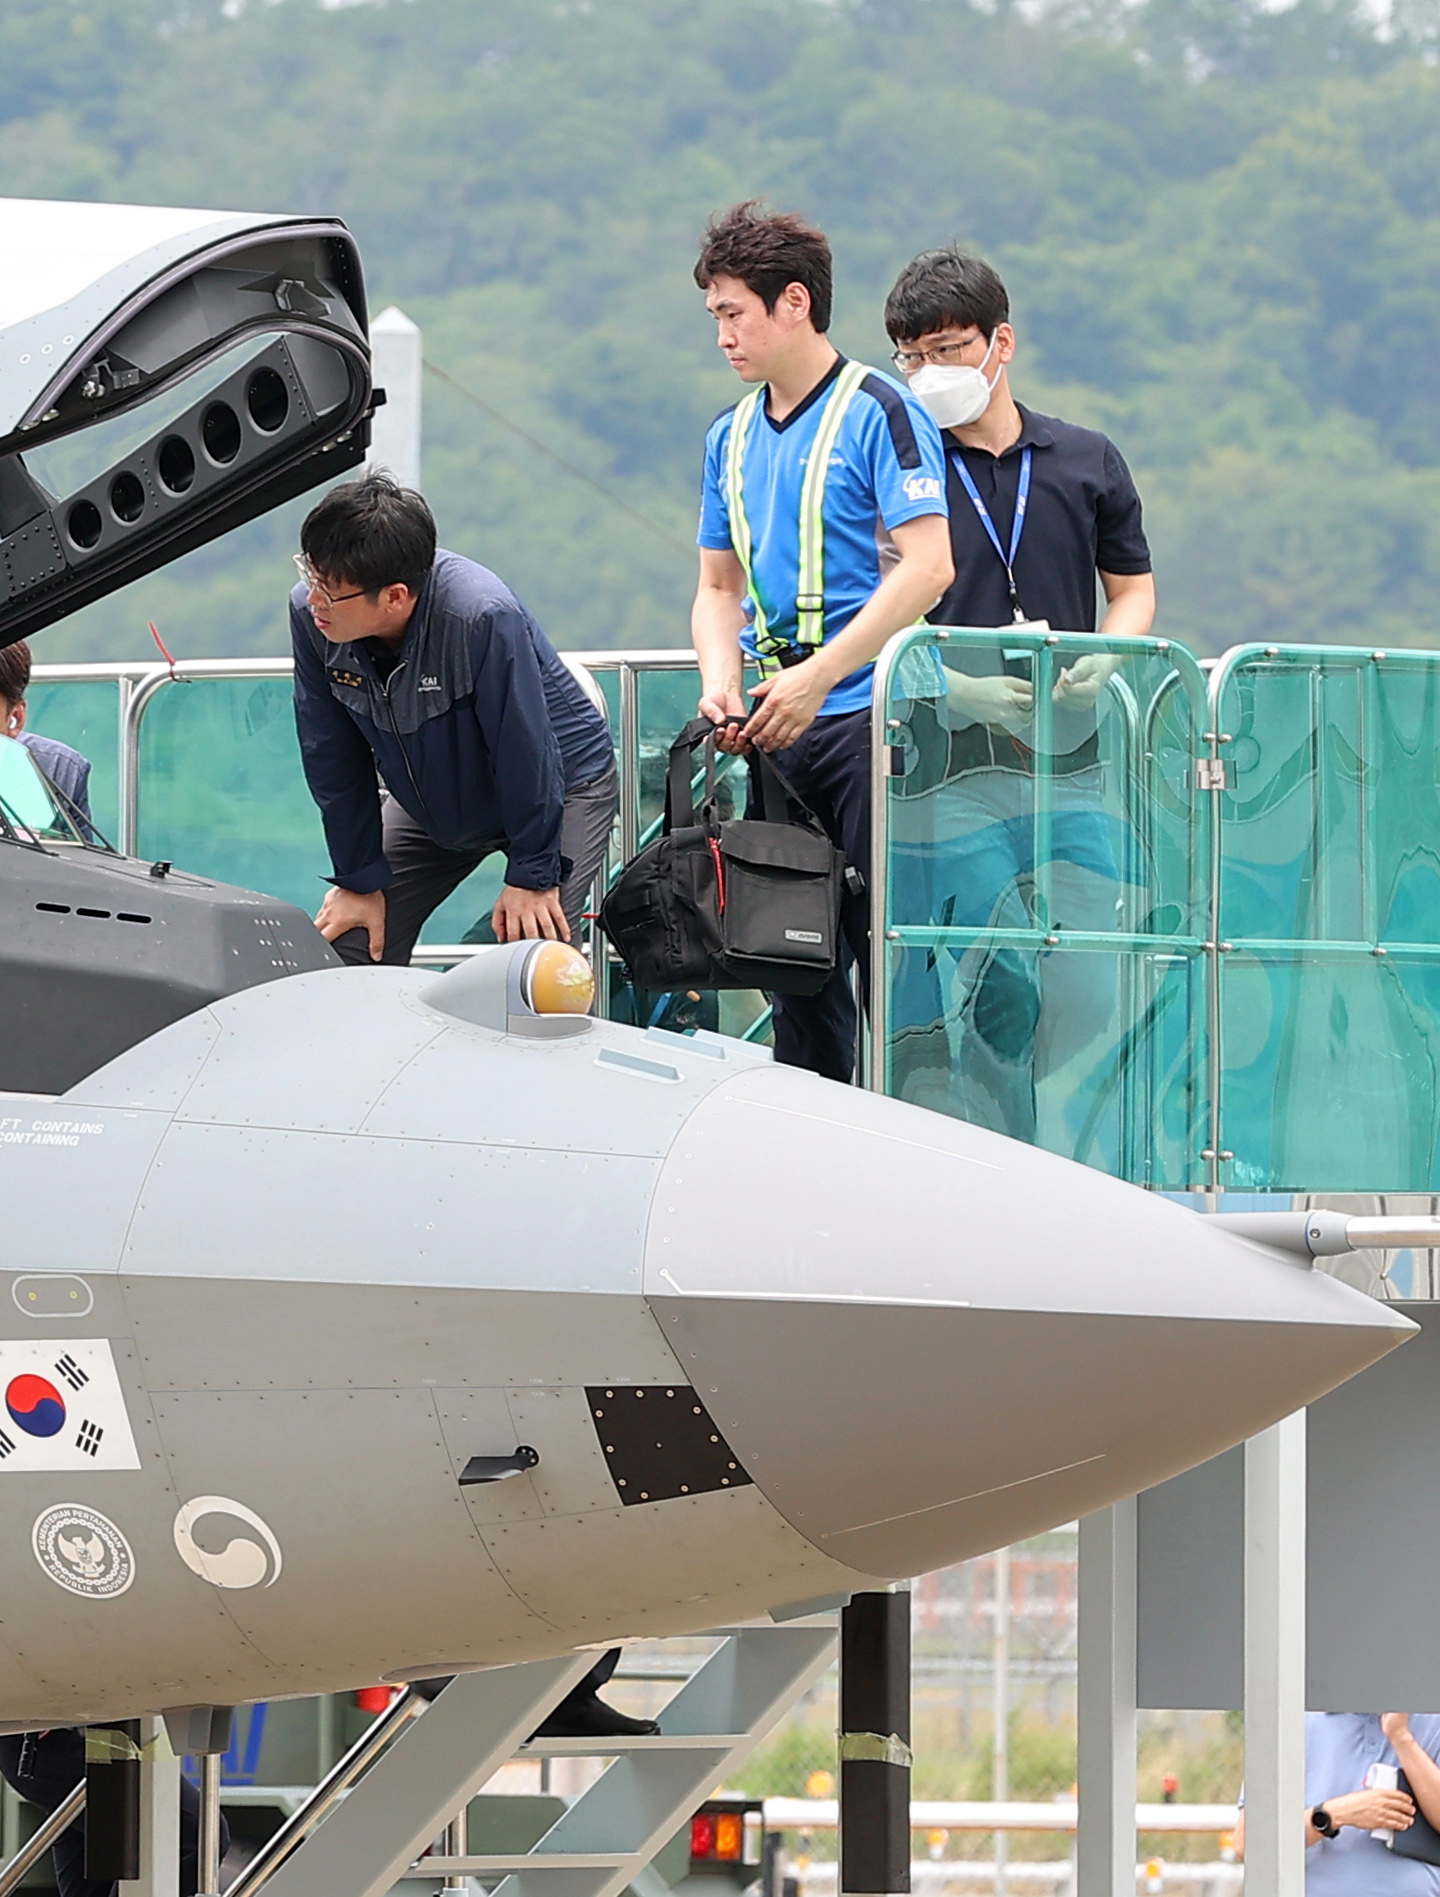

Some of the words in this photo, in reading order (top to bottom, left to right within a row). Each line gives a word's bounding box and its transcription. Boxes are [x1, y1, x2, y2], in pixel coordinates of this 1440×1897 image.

[421, 674, 437, 686] KAI
[32, 1120, 104, 1135] CONTAINS
[39, 1509, 71, 1551] KEMENTERIAN
[72, 1509, 123, 1548] PERTAHANAN
[49, 1564, 94, 1592] REPUBLIK
[98, 1563, 129, 1593] INDONESIA
